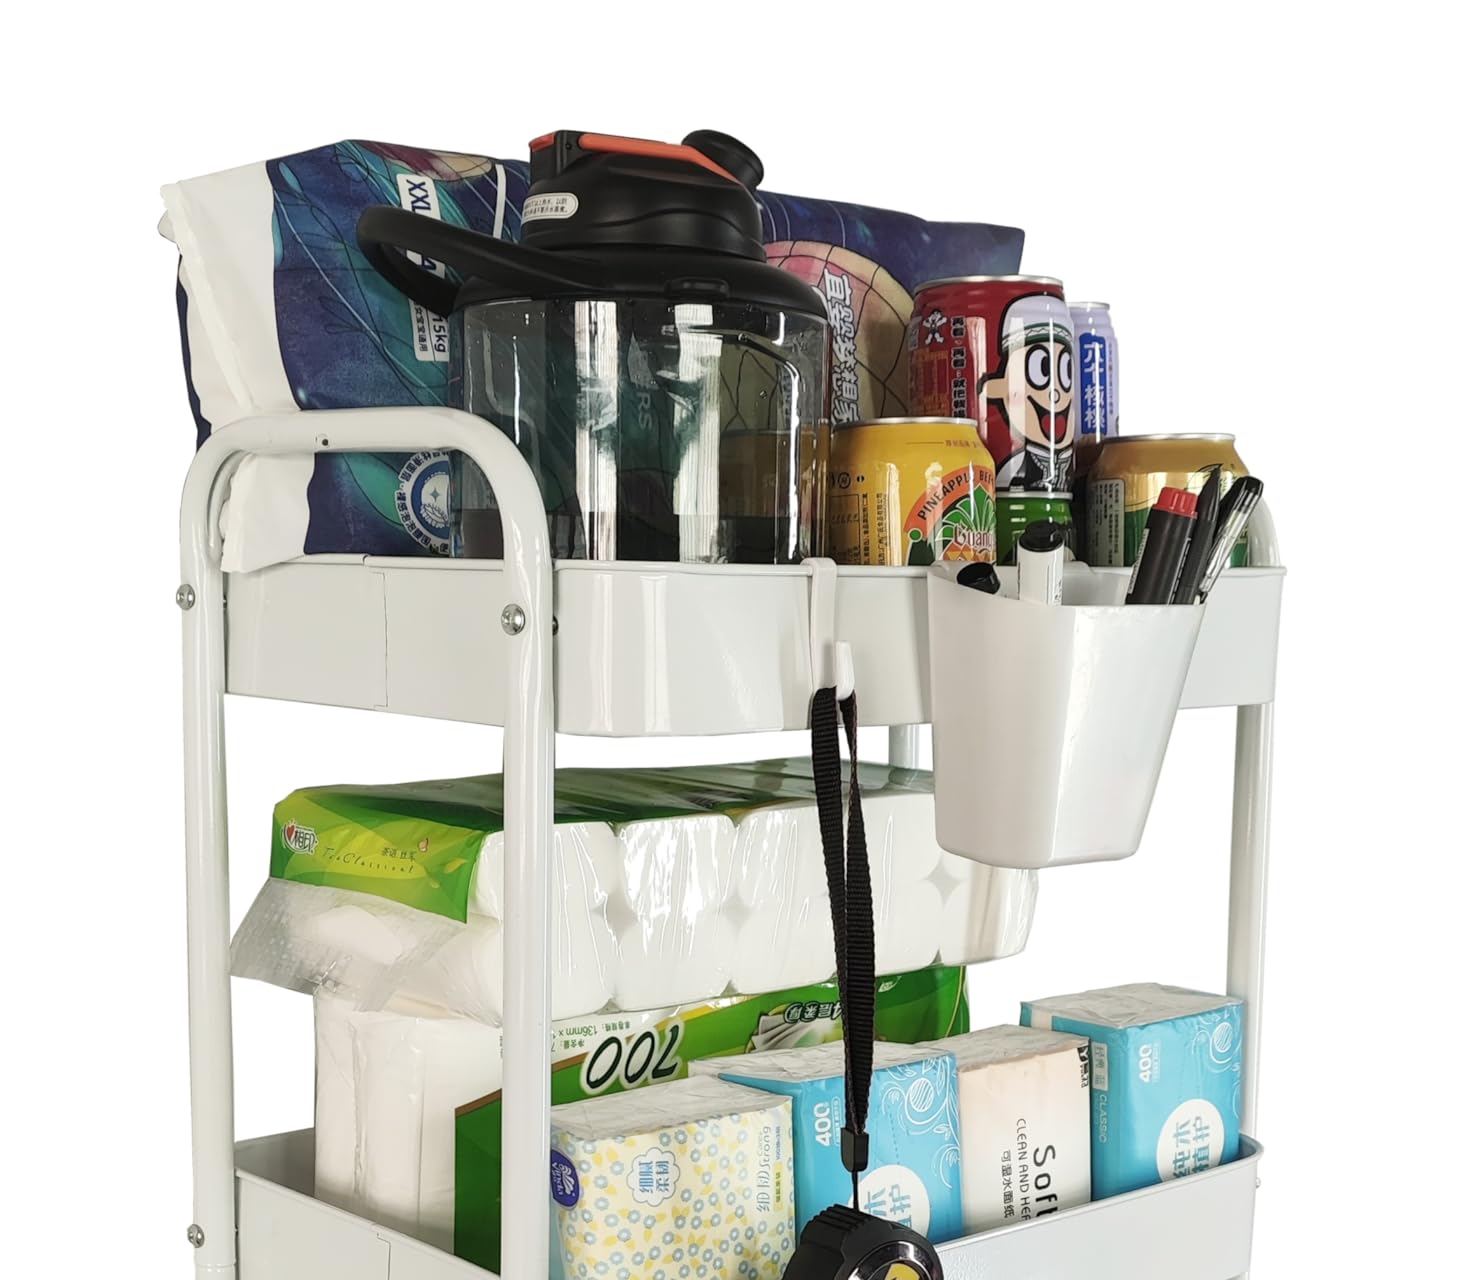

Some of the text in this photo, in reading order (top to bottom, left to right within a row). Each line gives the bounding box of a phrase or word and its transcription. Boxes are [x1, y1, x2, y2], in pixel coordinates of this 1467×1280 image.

[587, 1024, 680, 1090] 700
[1139, 1044, 1153, 1084] 400
[814, 1103, 832, 1147] 400
[1016, 1119, 1028, 1161] CLEAN
[1018, 1164, 1029, 1194] AND
